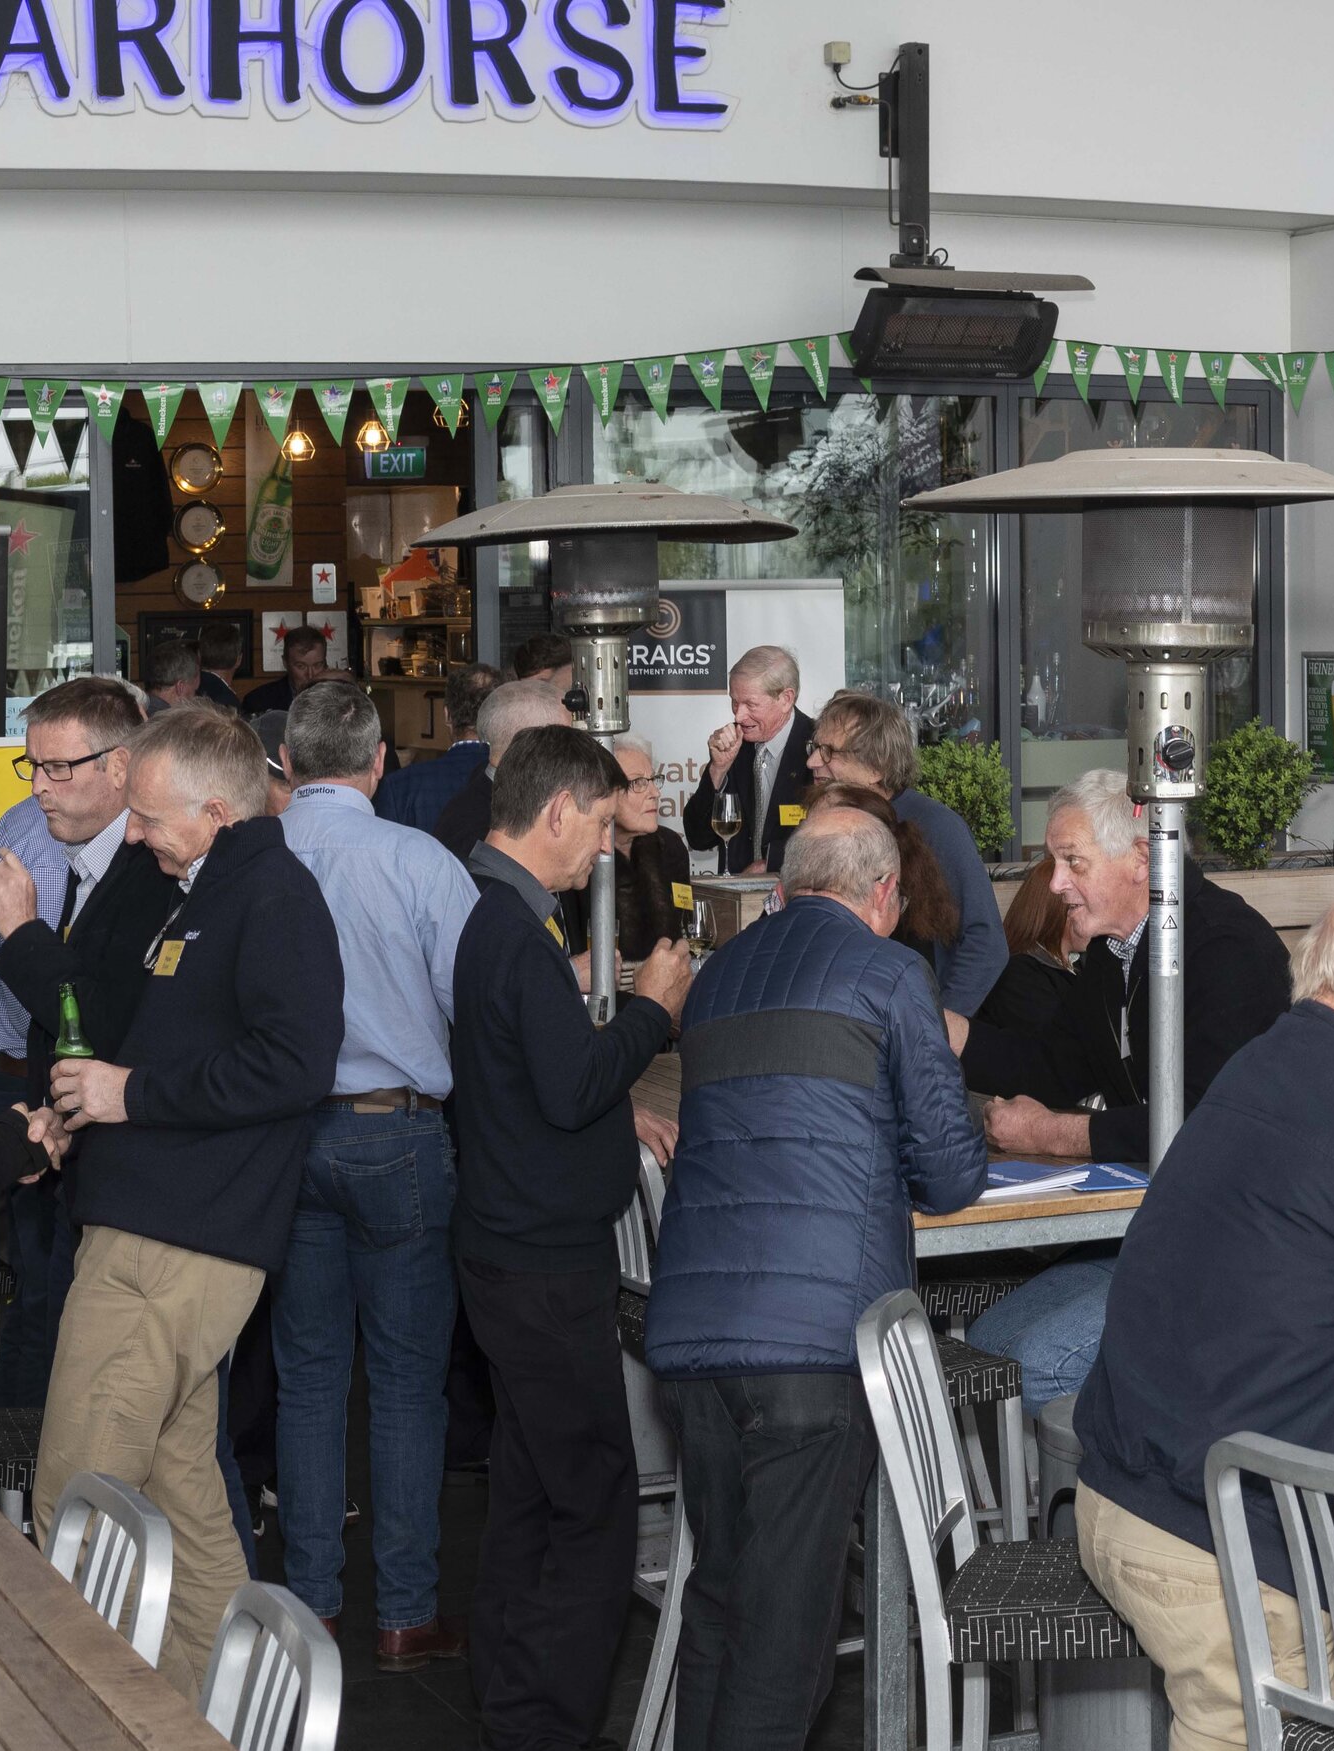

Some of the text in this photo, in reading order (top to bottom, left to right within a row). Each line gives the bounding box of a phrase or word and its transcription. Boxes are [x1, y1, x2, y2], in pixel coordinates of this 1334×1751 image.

[812, 351, 825, 388] Heineken
[1168, 365, 1179, 399] Heineken
[385, 393, 395, 433] Heineken
[601, 379, 610, 416] Heineken
[158, 396, 167, 437] Heineken
[380, 454, 416, 473] EXIT
[629, 668, 710, 676] ESTMENT PARTNERS
[297, 786, 336, 796] fertigation
